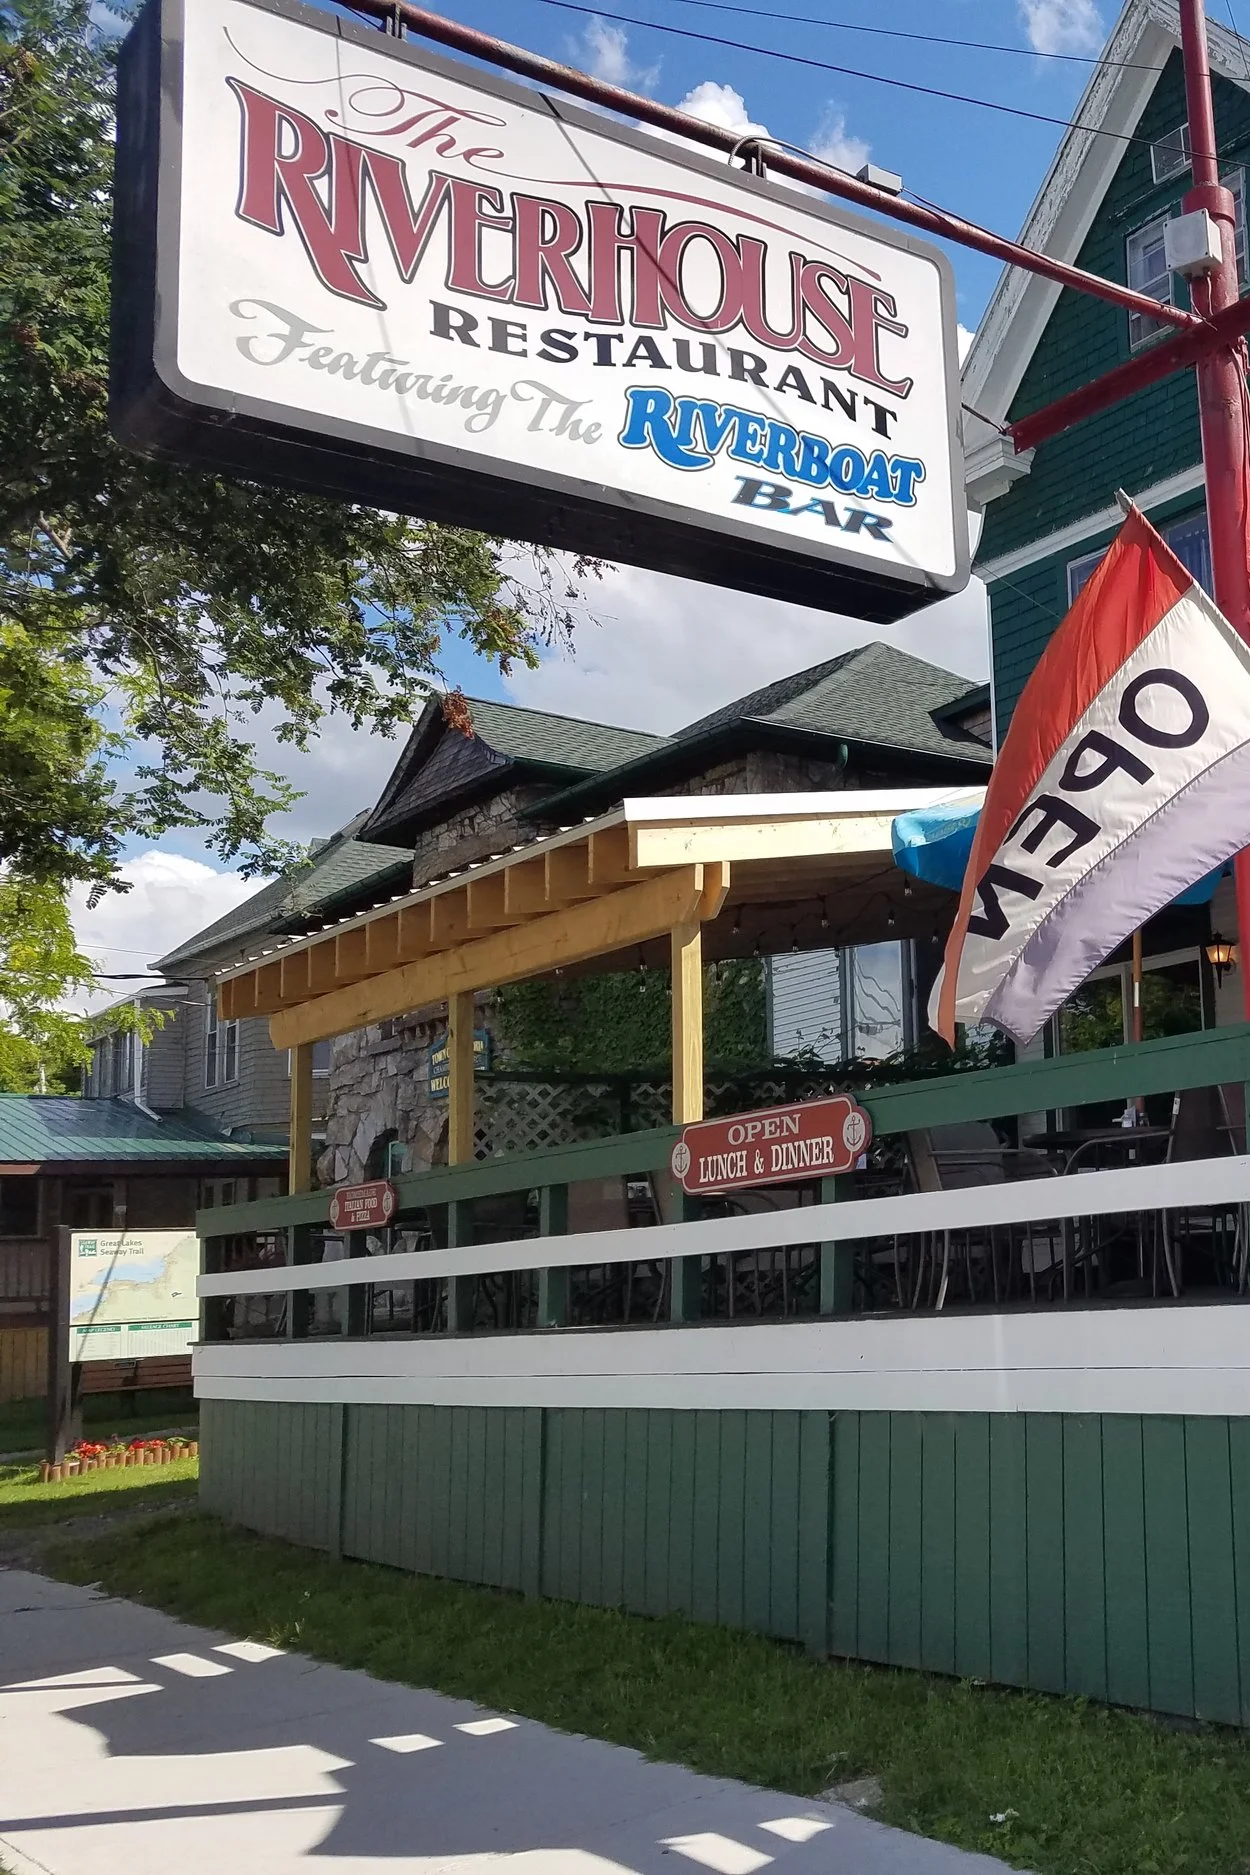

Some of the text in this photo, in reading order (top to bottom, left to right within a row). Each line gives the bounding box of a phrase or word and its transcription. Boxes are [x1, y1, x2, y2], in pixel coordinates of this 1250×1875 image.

[225, 76, 913, 400] RIVERHOUSE
[229, 299, 602, 445] Featuring The
[429, 300, 898, 440] RESTAURANT
[617, 385, 926, 508] RIVERBOAT
[730, 475, 894, 544] BAR
[728, 1114, 802, 1146] OPEN
[699, 1136, 835, 1183] LUNCH & DINNER
[356, 1210, 370, 1222] PIZZA
[364, 1197, 377, 1209] FOOD
[100, 1239, 142, 1247] Great Lakes
[100, 1248, 127, 1256] Seaway
